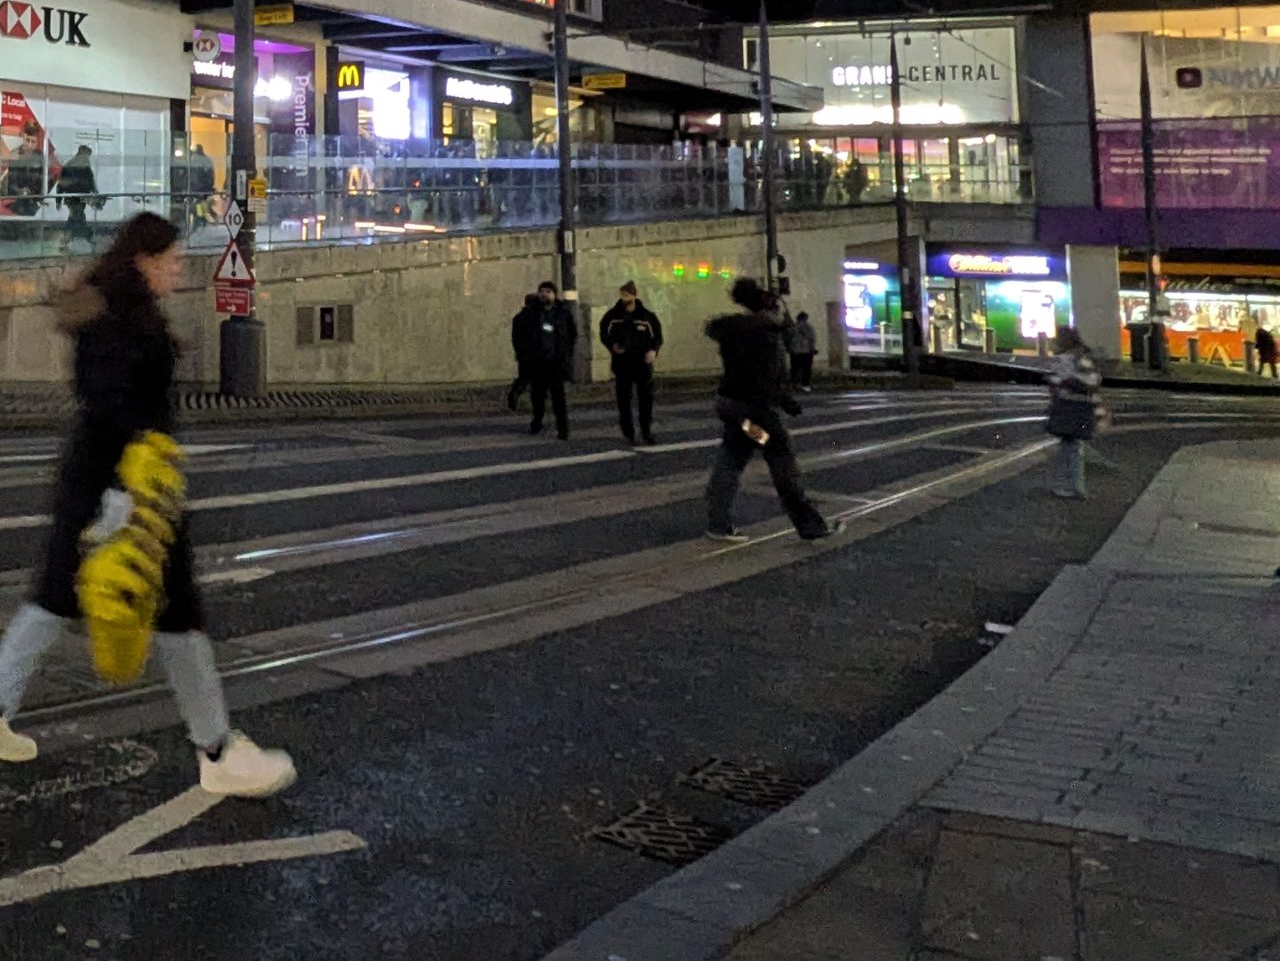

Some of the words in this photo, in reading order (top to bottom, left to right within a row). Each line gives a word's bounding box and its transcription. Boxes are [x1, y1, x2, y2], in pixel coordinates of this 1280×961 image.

[41, 7, 91, 48] UK
[908, 64, 1000, 82] CENTRAL
[294, 75, 310, 146] Premier
[228, 213, 243, 226] 10
